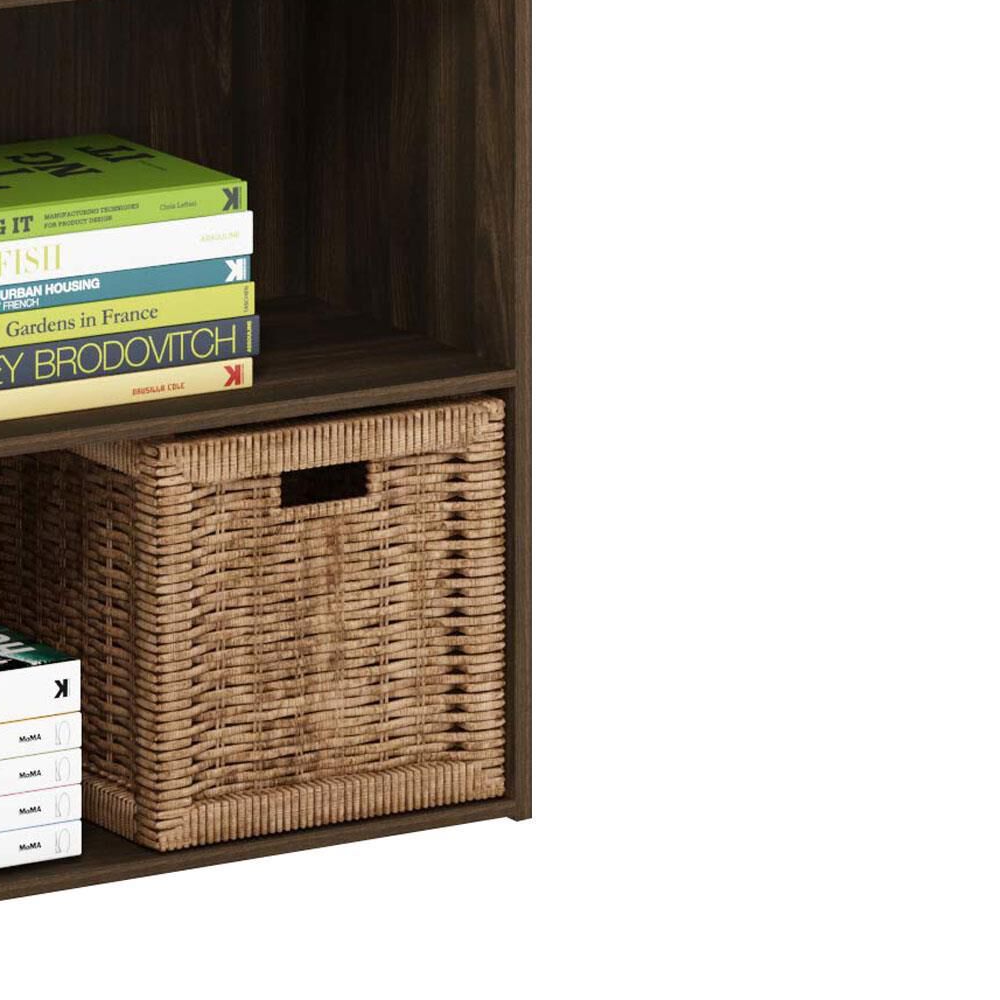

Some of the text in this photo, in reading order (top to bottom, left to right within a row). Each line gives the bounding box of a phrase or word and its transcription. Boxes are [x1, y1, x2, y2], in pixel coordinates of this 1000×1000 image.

[44, 207, 99, 221] MANUFACTURING
[12, 215, 34, 234] IT
[44, 221, 57, 230] FOR
[0, 285, 43, 302] URBAN
[45, 277, 100, 296] HOUSING
[3, 297, 40, 311] FRENCH
[6, 307, 159, 338] Gardens in France
[35, 324, 236, 381] BRODOVITCH
[19, 733, 42, 744] MoMA
[19, 769, 42, 780] MoMA
[19, 805, 42, 816] MoMA
[19, 841, 42, 852] MoMA
